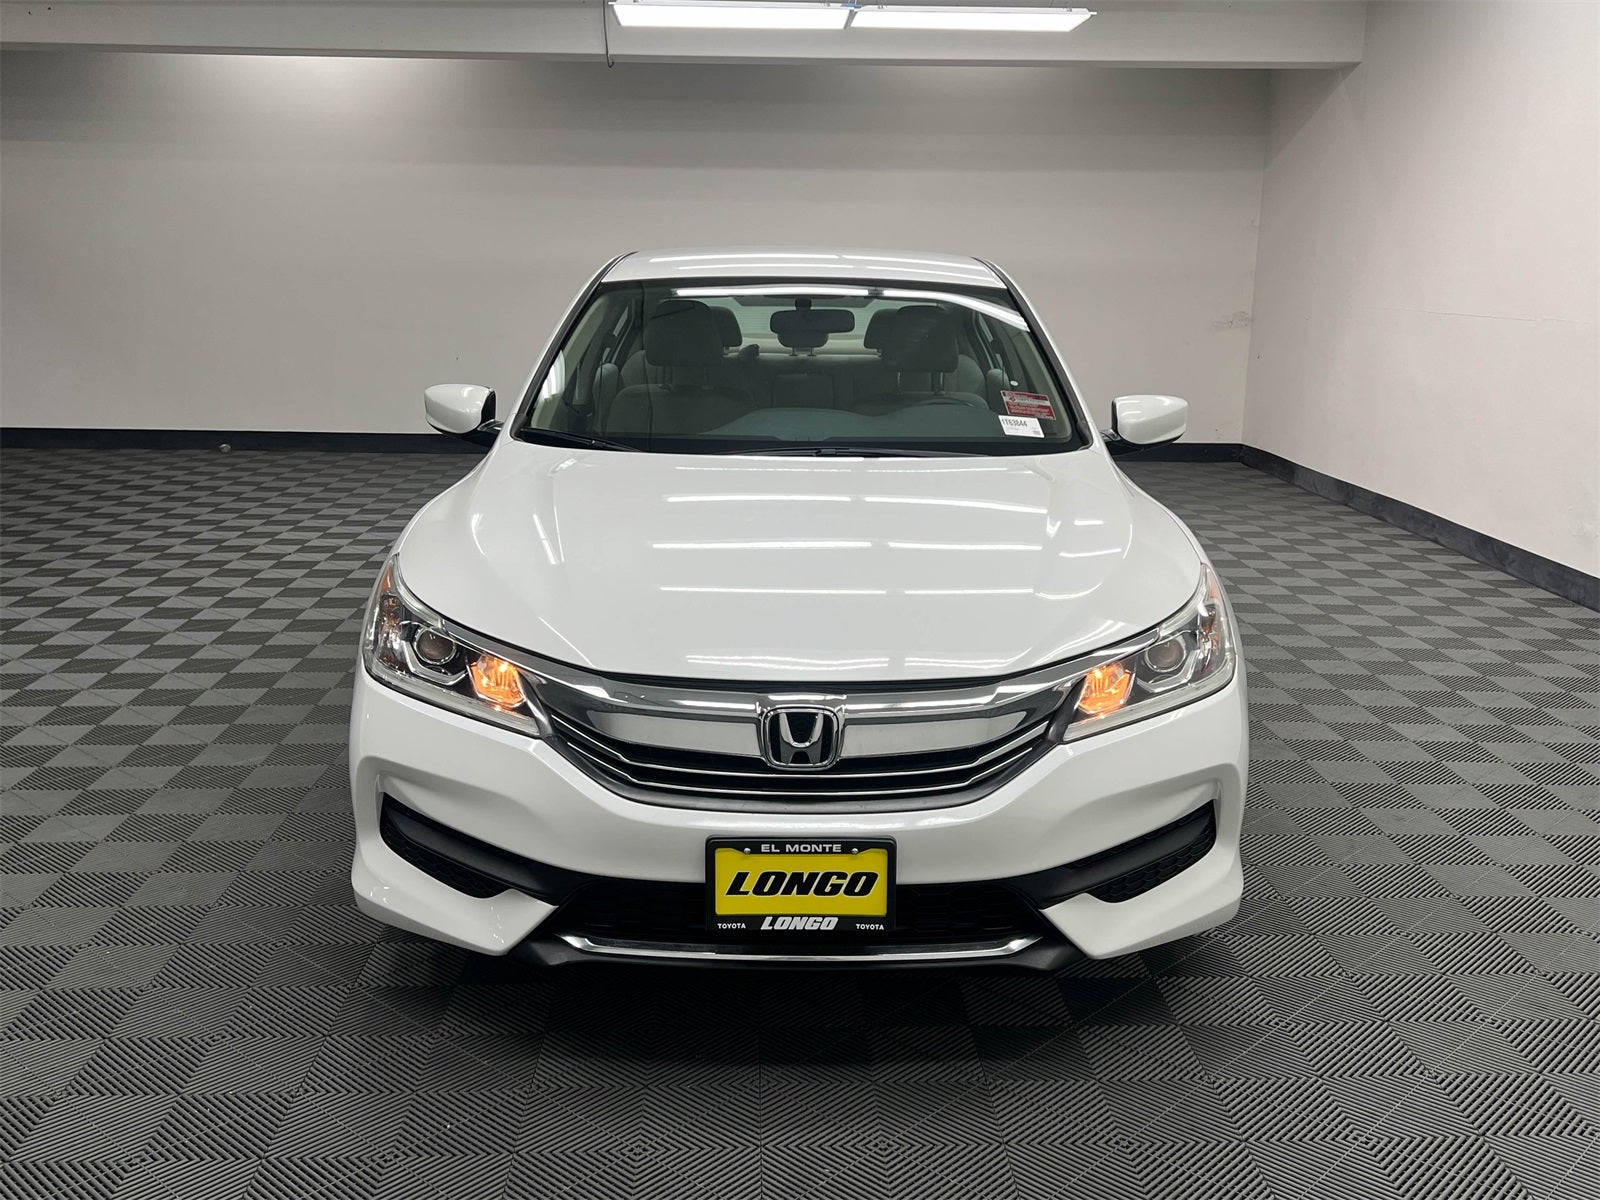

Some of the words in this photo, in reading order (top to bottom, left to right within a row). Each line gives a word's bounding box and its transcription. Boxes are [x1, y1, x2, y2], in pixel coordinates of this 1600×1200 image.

[761, 844, 780, 852] EL
[786, 844, 841, 852] MONTE
[725, 871, 879, 897] LONGO
[760, 917, 839, 930] LONGO
